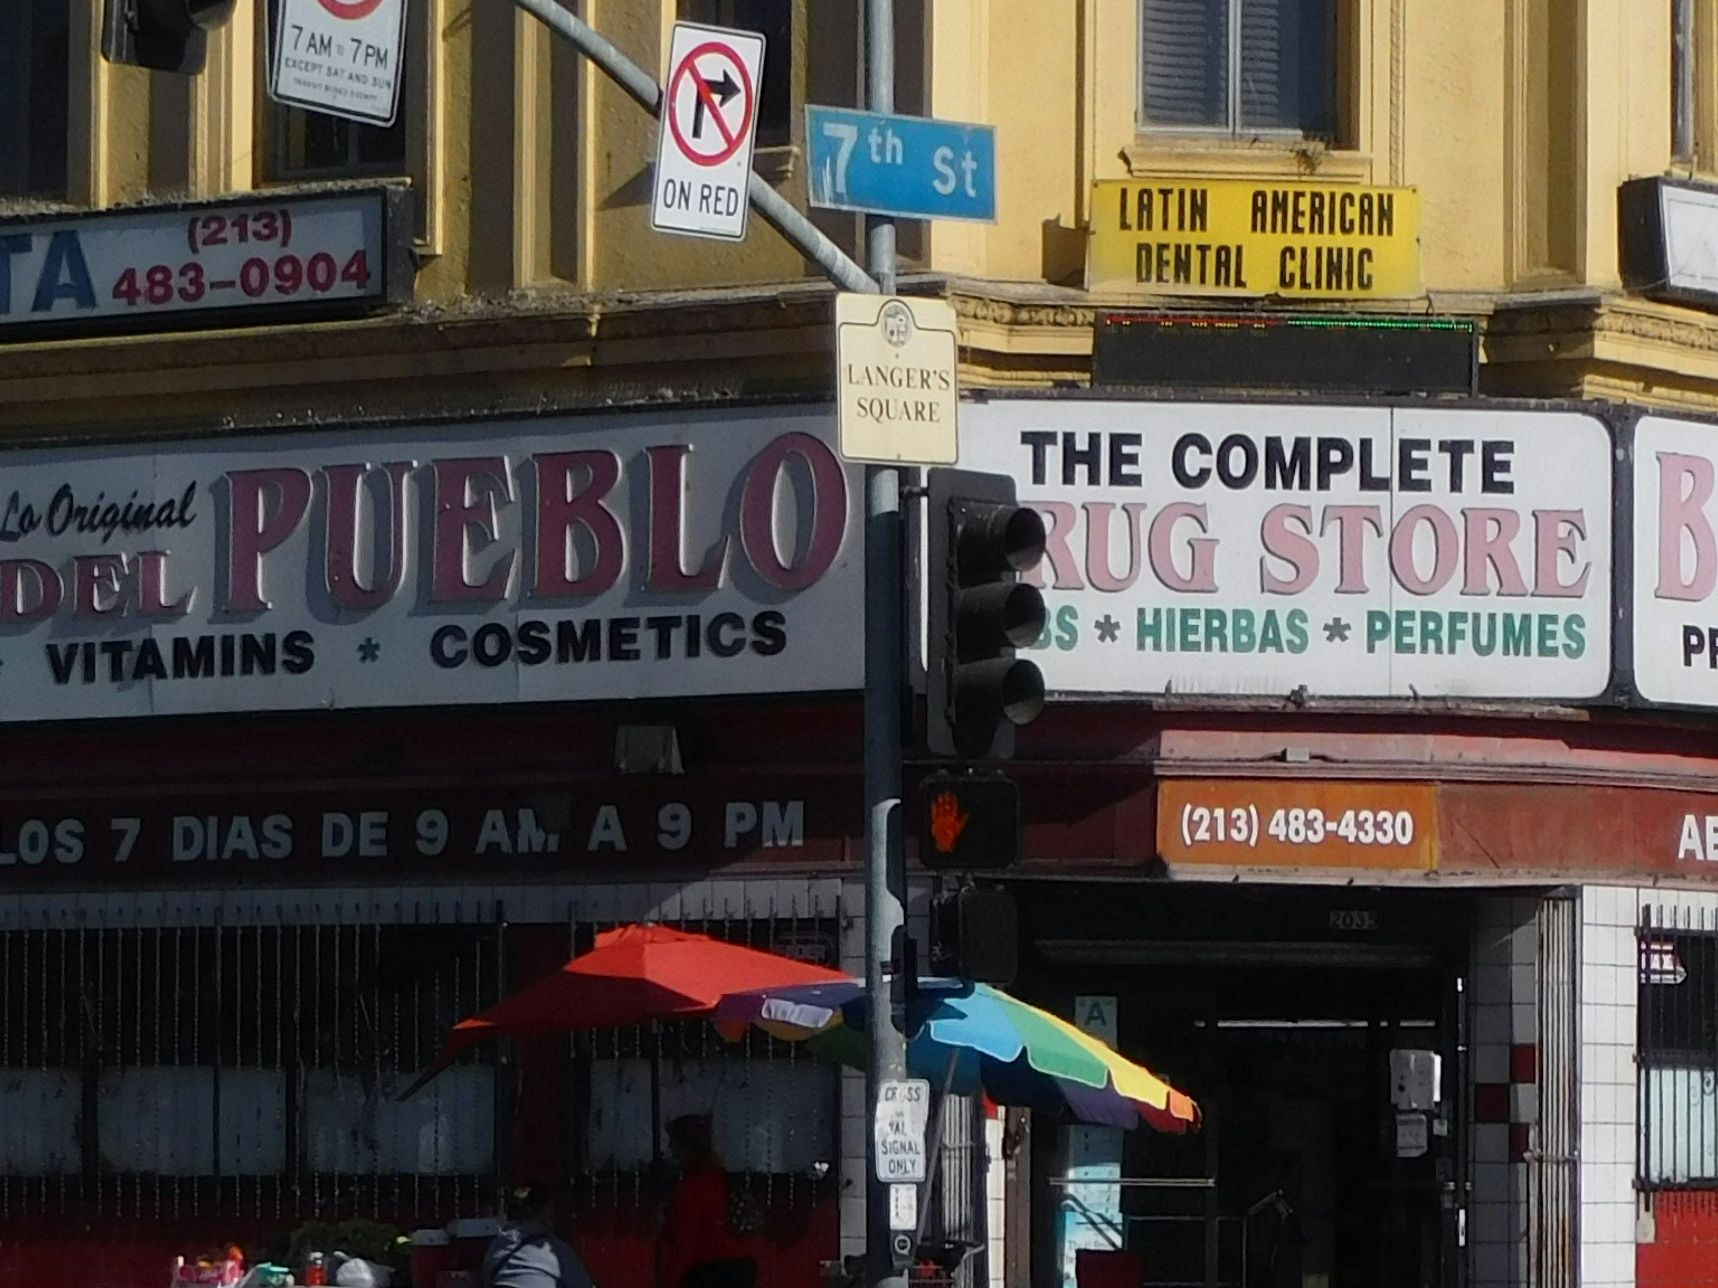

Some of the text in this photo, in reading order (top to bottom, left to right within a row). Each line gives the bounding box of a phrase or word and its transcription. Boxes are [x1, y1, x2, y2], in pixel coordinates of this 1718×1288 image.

[291, 24, 303, 51] 7
[306, 31, 332, 58] AM
[351, 37, 362, 64] 7
[364, 43, 388, 71] PM
[823, 122, 977, 198] 7th St
[663, 178, 739, 218] ON RED
[1119, 187, 1394, 238] LATIN AMERICAN
[188, 210, 293, 250] (213)
[112, 249, 371, 307] 483-0904
[1136, 242, 1374, 292] DENTAL CLINIC
[847, 363, 950, 391] LANGER'S
[856, 396, 941, 423] SQUARE
[1021, 431, 1516, 494] THE COMPLETE
[46, 479, 197, 545] Original
[225, 430, 847, 613] PUEBLO
[1018, 500, 1591, 599] RUG STORE
[45, 629, 316, 686] VITAMINS
[429, 610, 788, 669] COSMETICS
[1136, 607, 1309, 654] HIERBAS
[1366, 609, 1587, 660] PERFUMES
[110, 814, 142, 863] 7
[172, 811, 293, 861] DIAS
[321, 809, 389, 859] DE
[414, 807, 449, 856] 9
[586, 803, 628, 852] A
[657, 801, 693, 850] 9
[723, 798, 806, 849] PM
[1180, 803, 1414, 849] (213) 483-4330
[1084, 1001, 1108, 1026] A
[885, 1086, 921, 1103] CRSS
[881, 1139, 921, 1155] SIGNAL
[888, 1158, 917, 1176] ONLY
